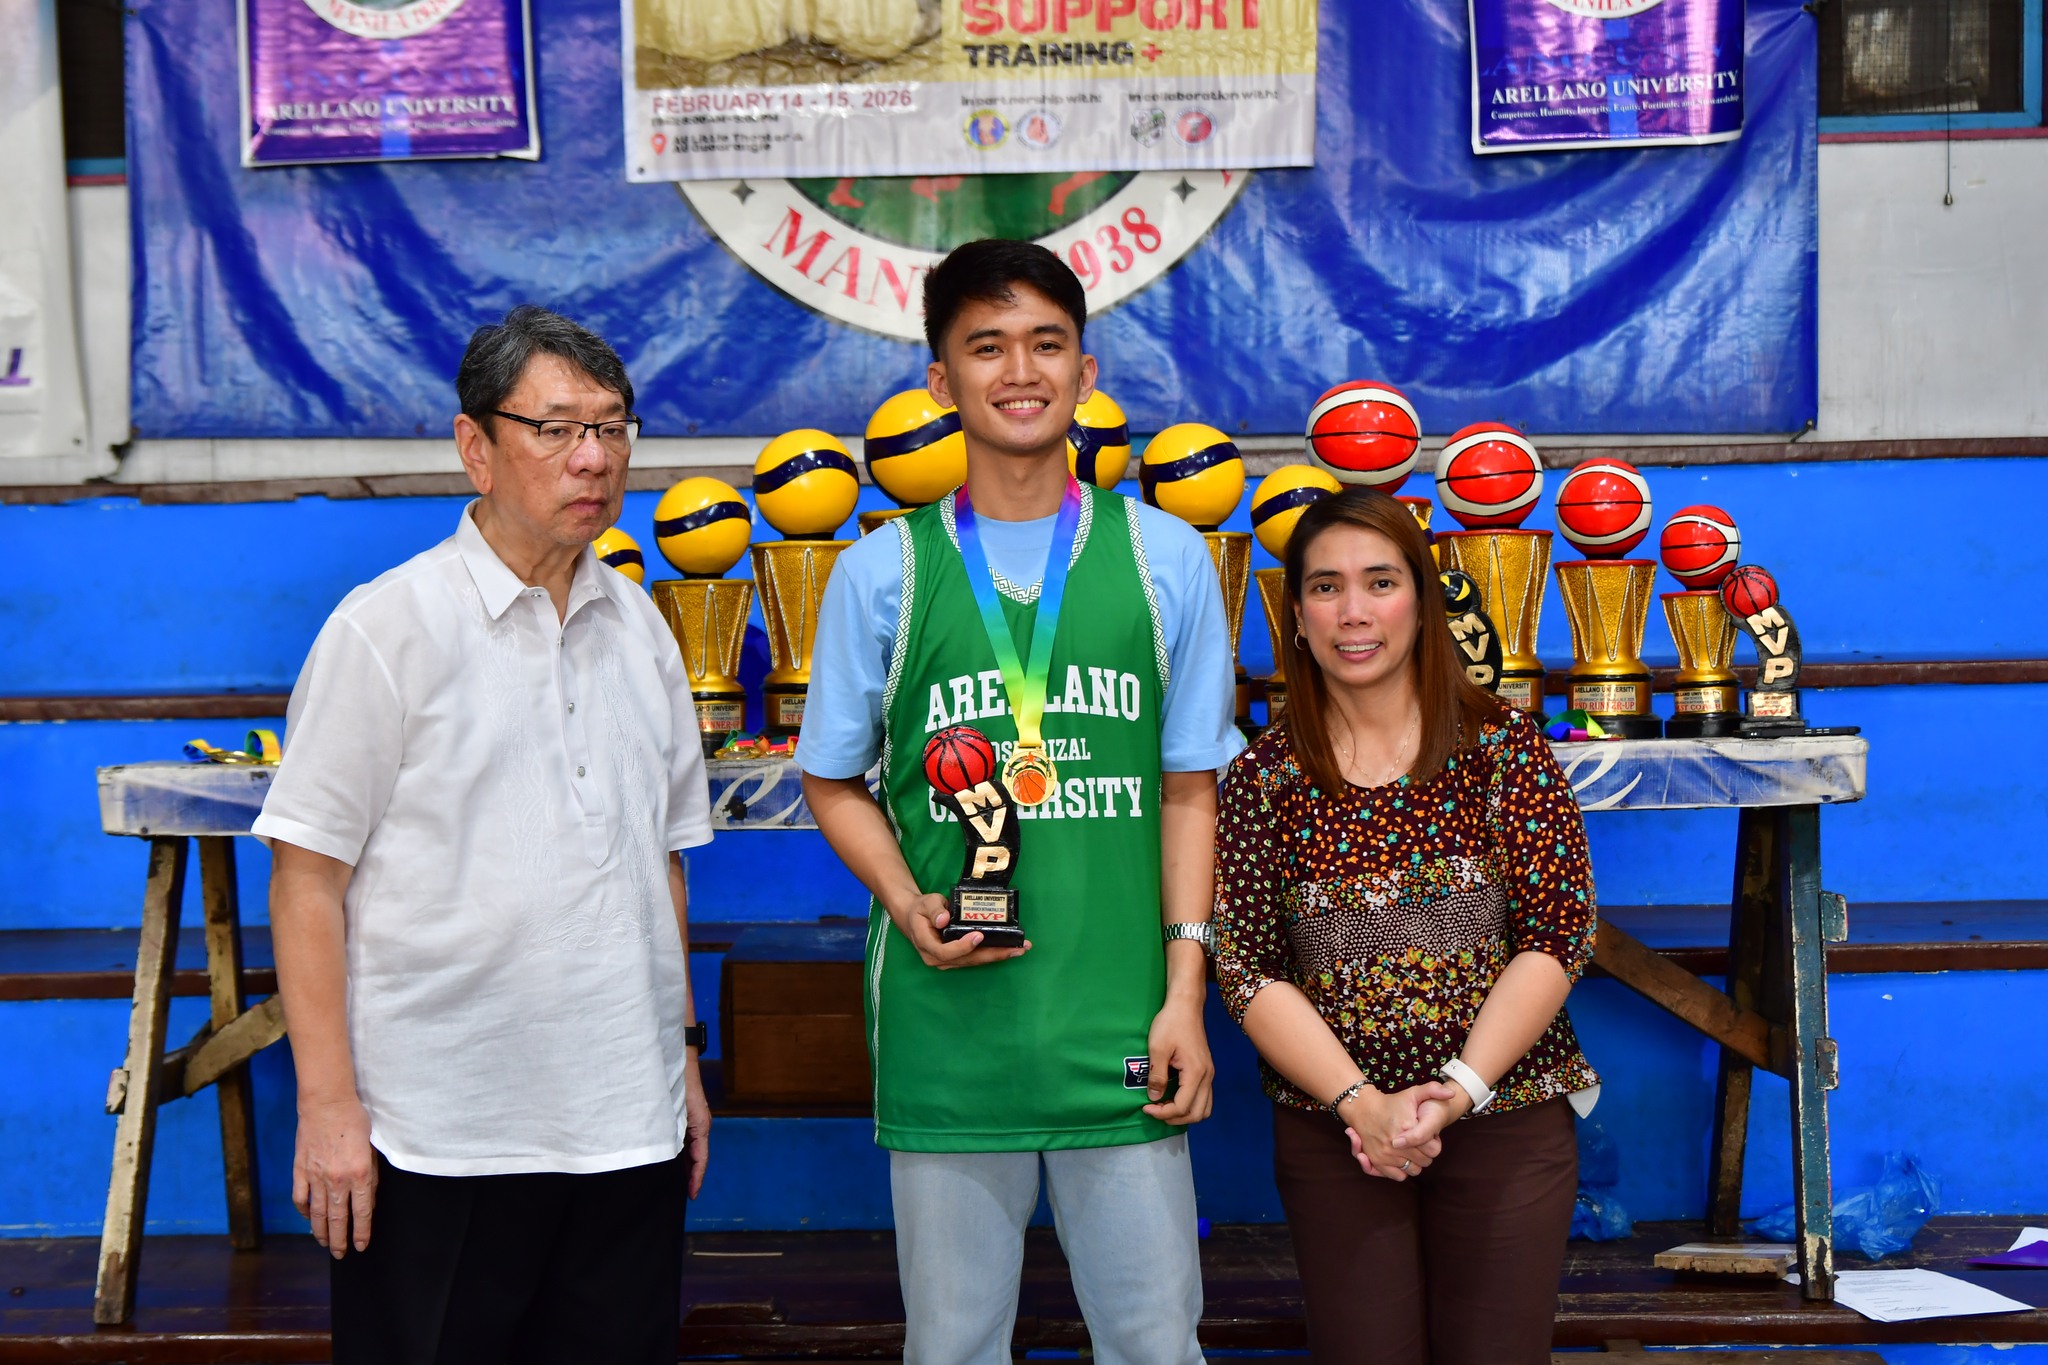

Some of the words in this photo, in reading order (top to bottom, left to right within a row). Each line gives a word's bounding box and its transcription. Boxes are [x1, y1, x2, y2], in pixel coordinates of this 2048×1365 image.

[962, 42, 1135, 68] TRAINING
[652, 93, 774, 113] FEBRUARY
[782, 93, 804, 109] 14
[862, 90, 912, 108] 2026
[1128, 93, 1141, 102] In
[1491, 81, 1608, 104] ARELLANO
[1613, 70, 1739, 96] UNIVERSITY
[268, 100, 381, 121] ARELLANO
[385, 96, 515, 116] UNIVERSITY
[1491, 108, 1538, 120] Competence,
[1539, 107, 1577, 118] Humility,
[1577, 104, 1612, 117] Integrity,
[1613, 102, 1641, 114] Equity,
[1642, 100, 1681, 110] Fortitude,
[761, 205, 924, 315] MAN
[1067, 206, 1163, 292] 938
[1745, 606, 1794, 684] MVP
[924, 664, 1141, 734] AREANO
[928, 776, 1143, 823] URSITY
[953, 780, 1011, 879] MVP
